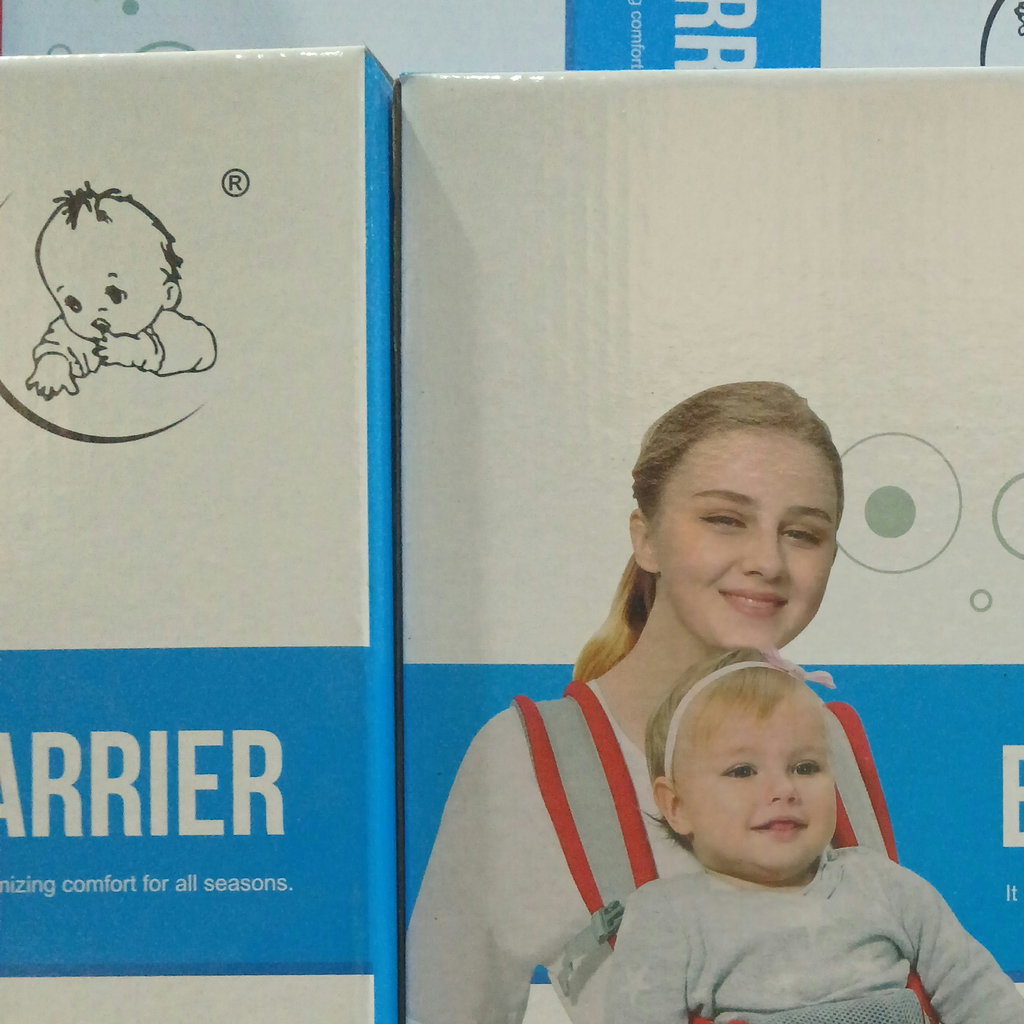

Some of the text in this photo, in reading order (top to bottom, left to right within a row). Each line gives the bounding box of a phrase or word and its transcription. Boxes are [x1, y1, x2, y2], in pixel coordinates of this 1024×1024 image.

[62, 874, 137, 893] comfort
[142, 874, 168, 893] for
[175, 873, 198, 892] all
[204, 875, 294, 893] seasons.
[1005, 884, 1018, 902] It
